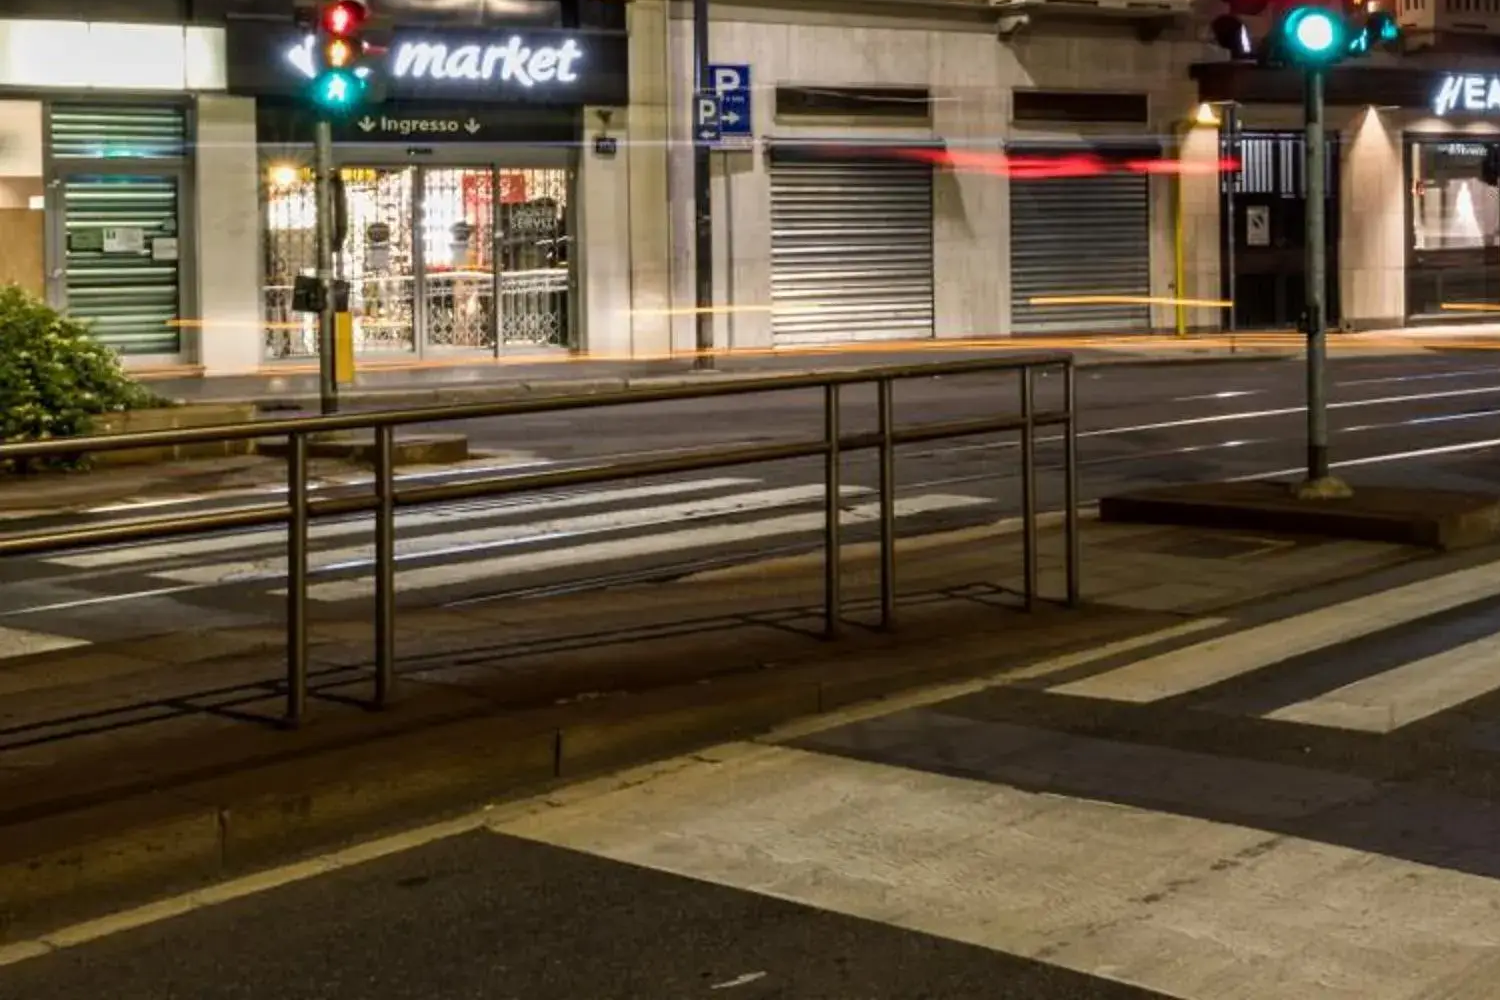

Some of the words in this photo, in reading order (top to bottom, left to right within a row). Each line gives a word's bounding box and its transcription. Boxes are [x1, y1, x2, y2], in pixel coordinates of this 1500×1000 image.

[393, 36, 583, 87] market
[715, 68, 741, 98] P
[381, 115, 459, 134] Ingresso
[699, 98, 717, 125] P
